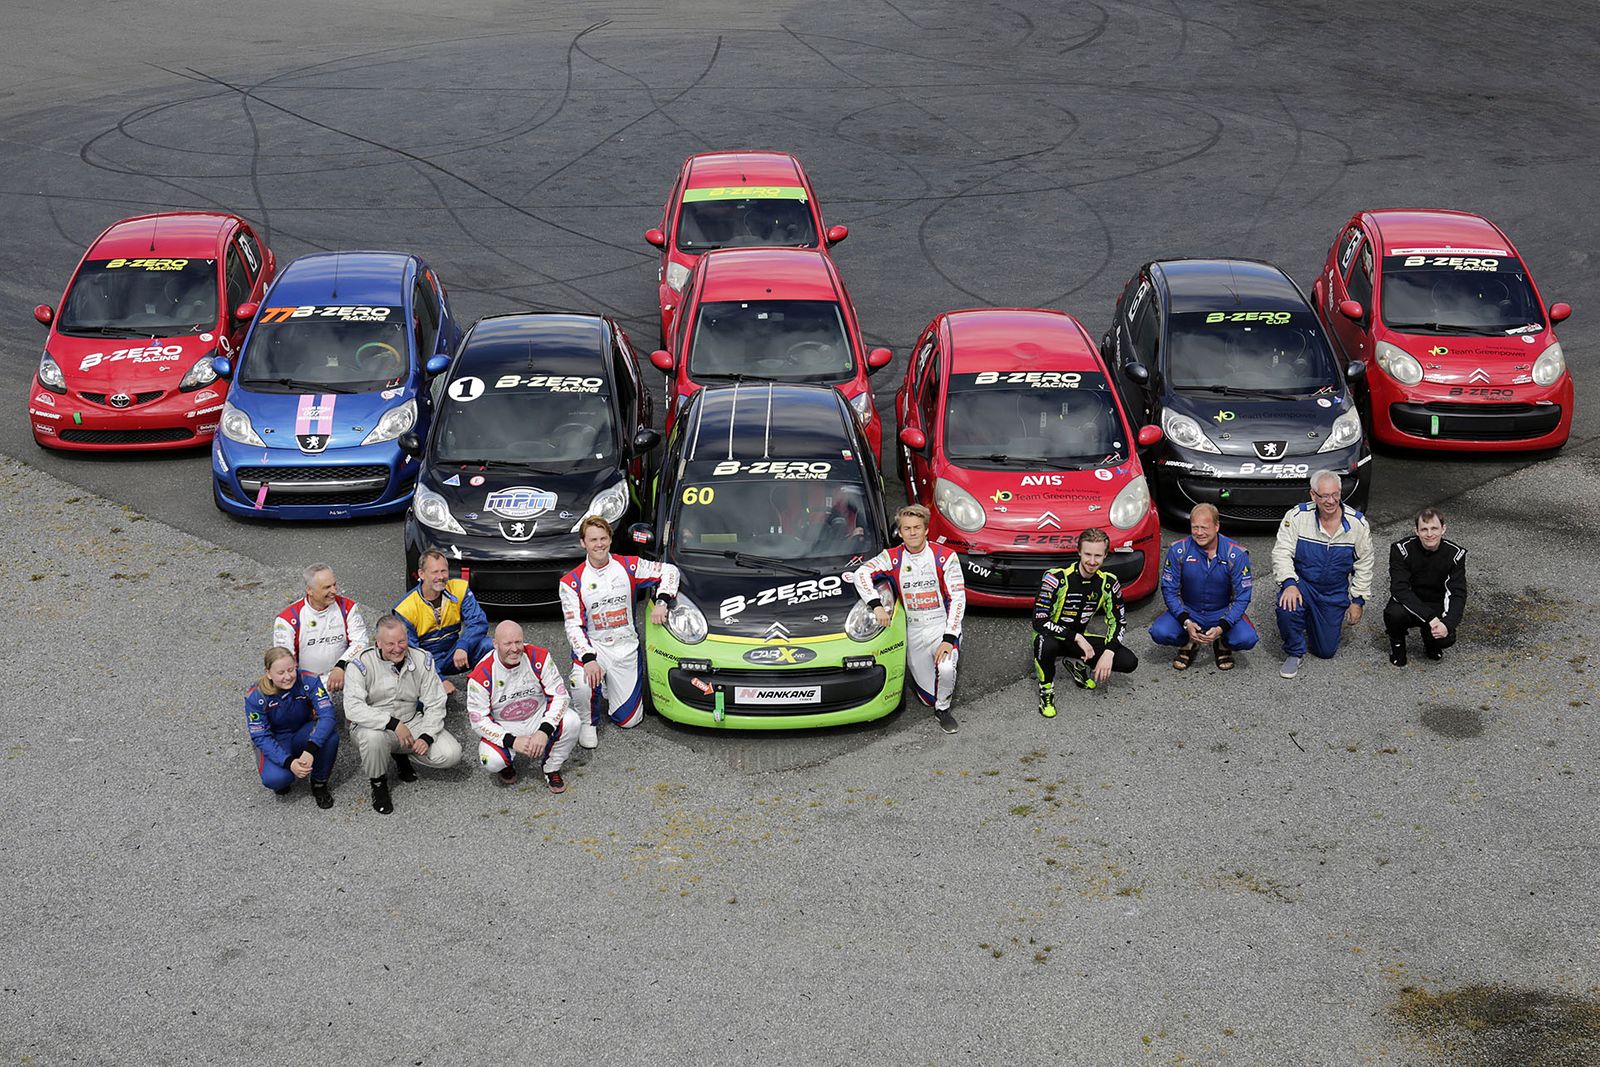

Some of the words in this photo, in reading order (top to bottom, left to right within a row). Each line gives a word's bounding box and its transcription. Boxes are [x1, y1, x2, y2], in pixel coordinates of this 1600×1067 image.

[105, 258, 189, 269] B-ZERO
[1404, 255, 1499, 267] B-ZERO
[259, 307, 298, 323] 77
[291, 306, 391, 317] B-ZERO
[1206, 312, 1292, 323] B-ZERO
[80, 345, 183, 370] B-ZERO
[132, 354, 180, 364] RACING
[1474, 349, 1526, 358] Greenpower
[974, 372, 1082, 385] B-ZERO
[457, 378, 474, 398] 1
[494, 375, 604, 388] B-ZERO
[1448, 387, 1514, 397] B-ZERO
[713, 461, 832, 476] B-ZERO
[1202, 462, 1224, 478] TOW
[1239, 463, 1309, 475] B-ZERO
[773, 472, 828, 480] RACING
[1020, 475, 1062, 486] AVIS
[682, 487, 715, 505] 60
[1015, 493, 1041, 501] Team
[1043, 492, 1102, 503] Greenpower
[1012, 535, 1080, 545] B-ZER
[966, 561, 991, 578] TOW
[903, 579, 936, 589] B-ZERO
[591, 594, 627, 609] B-ZERO
[719, 572, 843, 620] B-ZERO
[787, 586, 843, 607] RACING
[1043, 621, 1064, 634] AVIS
[307, 633, 344, 646] B-ZERO
[756, 689, 817, 699] NANKANG
